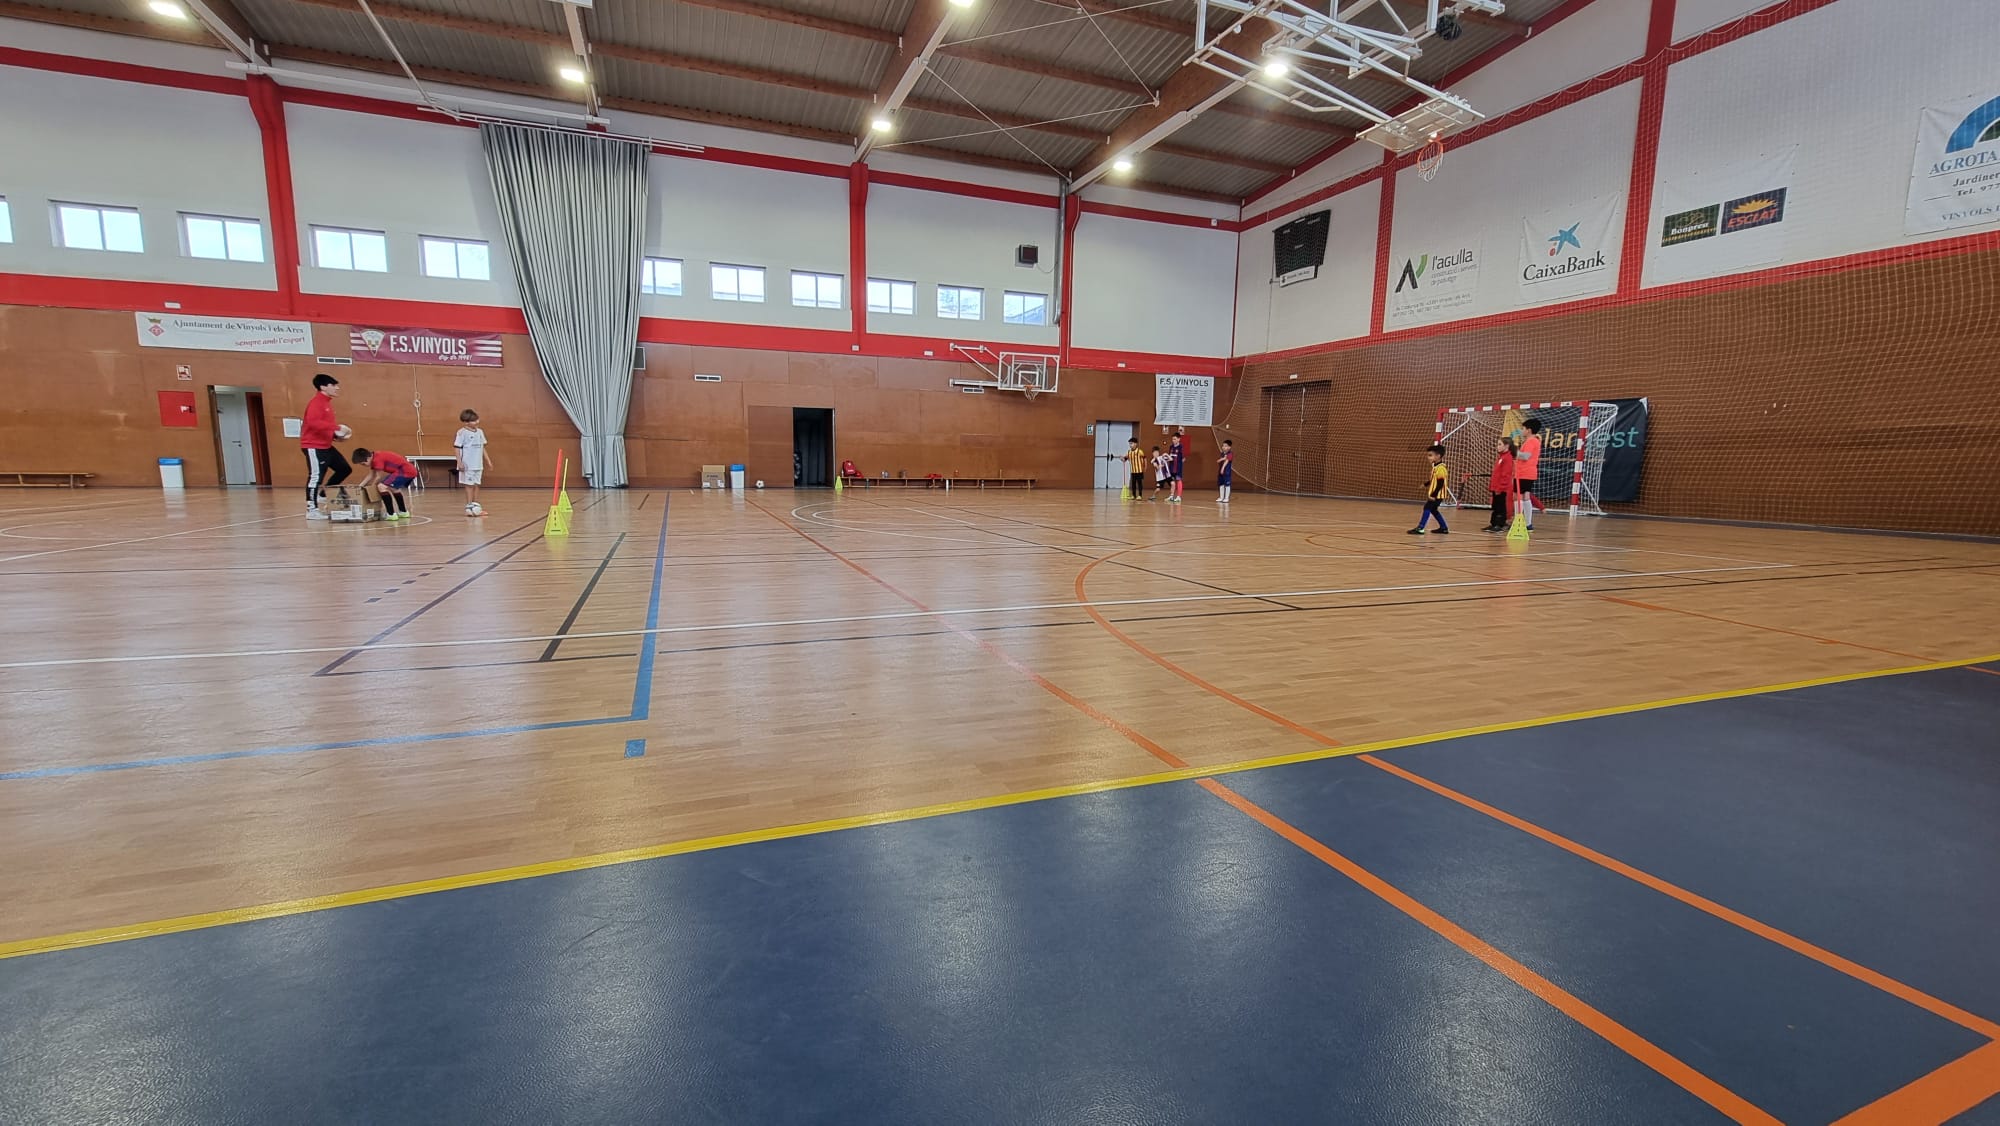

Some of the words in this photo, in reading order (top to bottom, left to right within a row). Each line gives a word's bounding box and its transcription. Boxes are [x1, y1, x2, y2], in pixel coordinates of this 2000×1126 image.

[1727, 208, 1777, 229] ESCLAT
[1671, 222, 1709, 236] Bonpreu
[1523, 251, 1605, 281] CaixaBank
[173, 319, 222, 330] Ajuntament
[236, 323, 267, 334] Vinyols
[1176, 378, 1209, 387] VINYOLS
